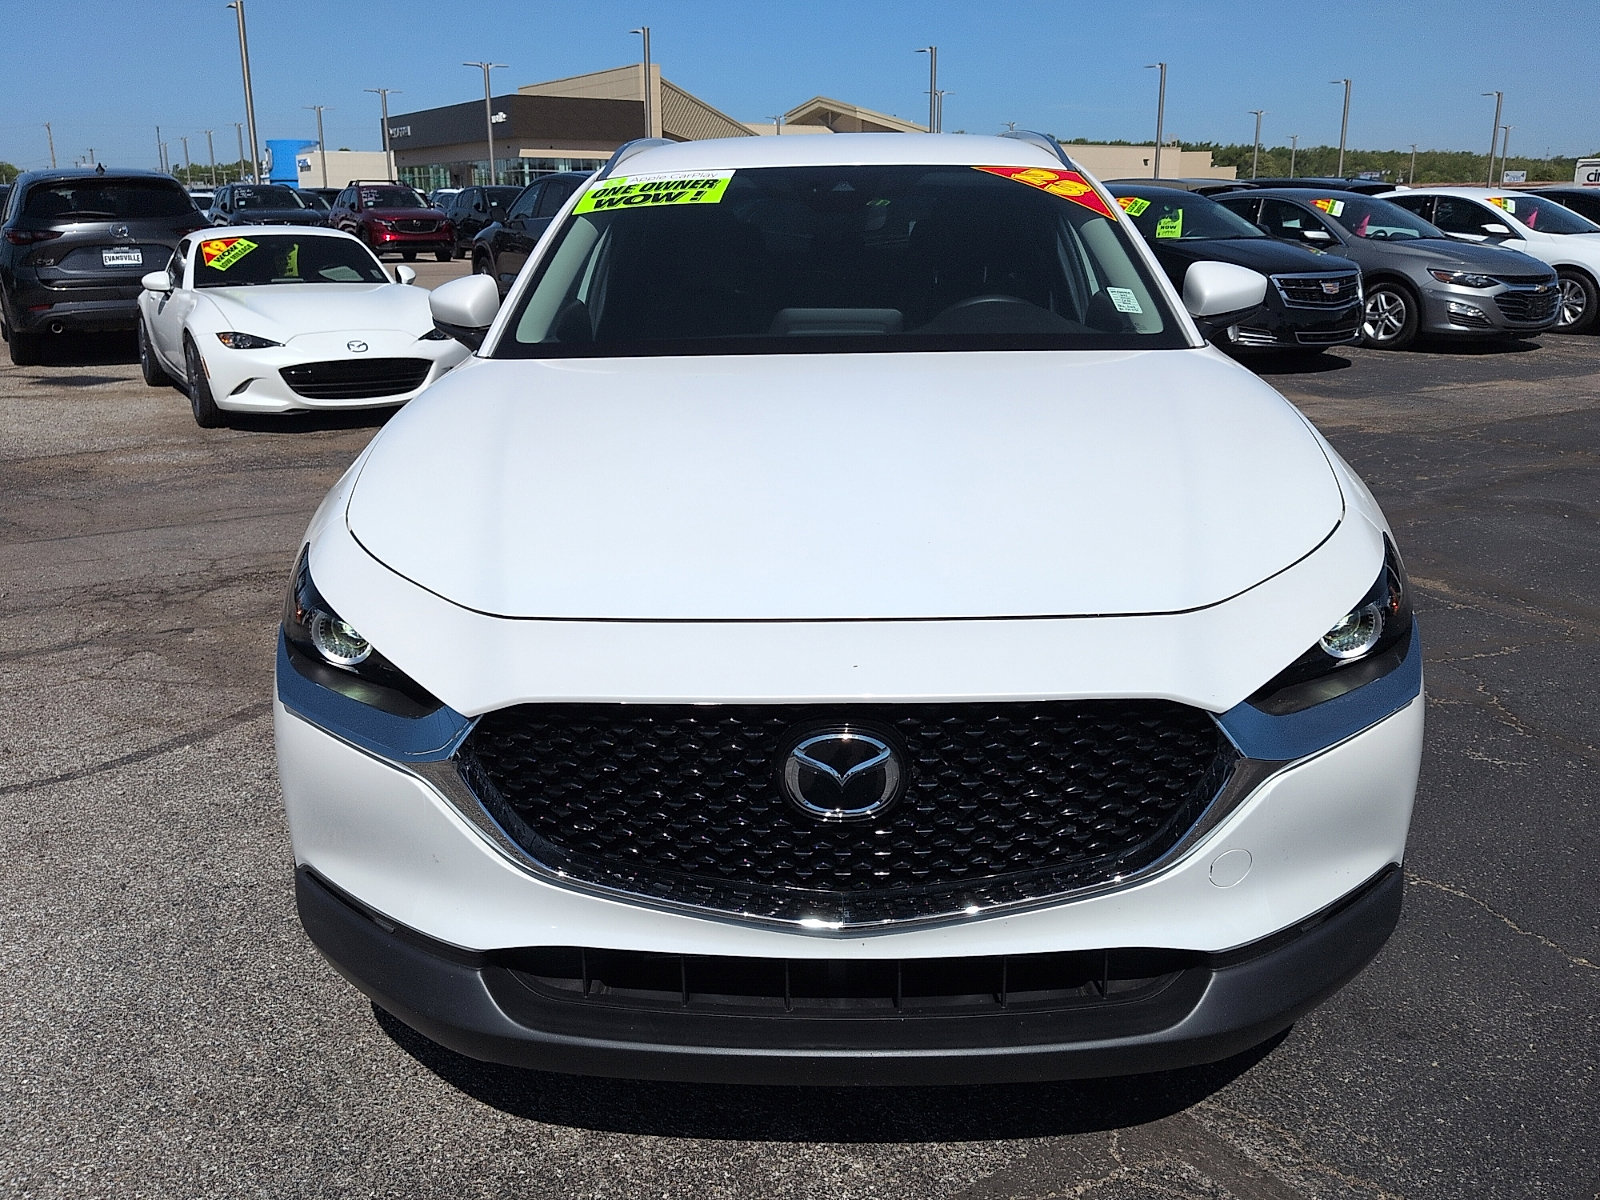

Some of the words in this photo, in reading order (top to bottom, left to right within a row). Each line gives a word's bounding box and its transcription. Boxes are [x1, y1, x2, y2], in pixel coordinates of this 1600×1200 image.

[631, 174, 667, 183] Apple
[591, 184, 639, 198] ONE
[639, 179, 721, 192] OWNER
[104, 254, 141, 263] EVANSVILLE
